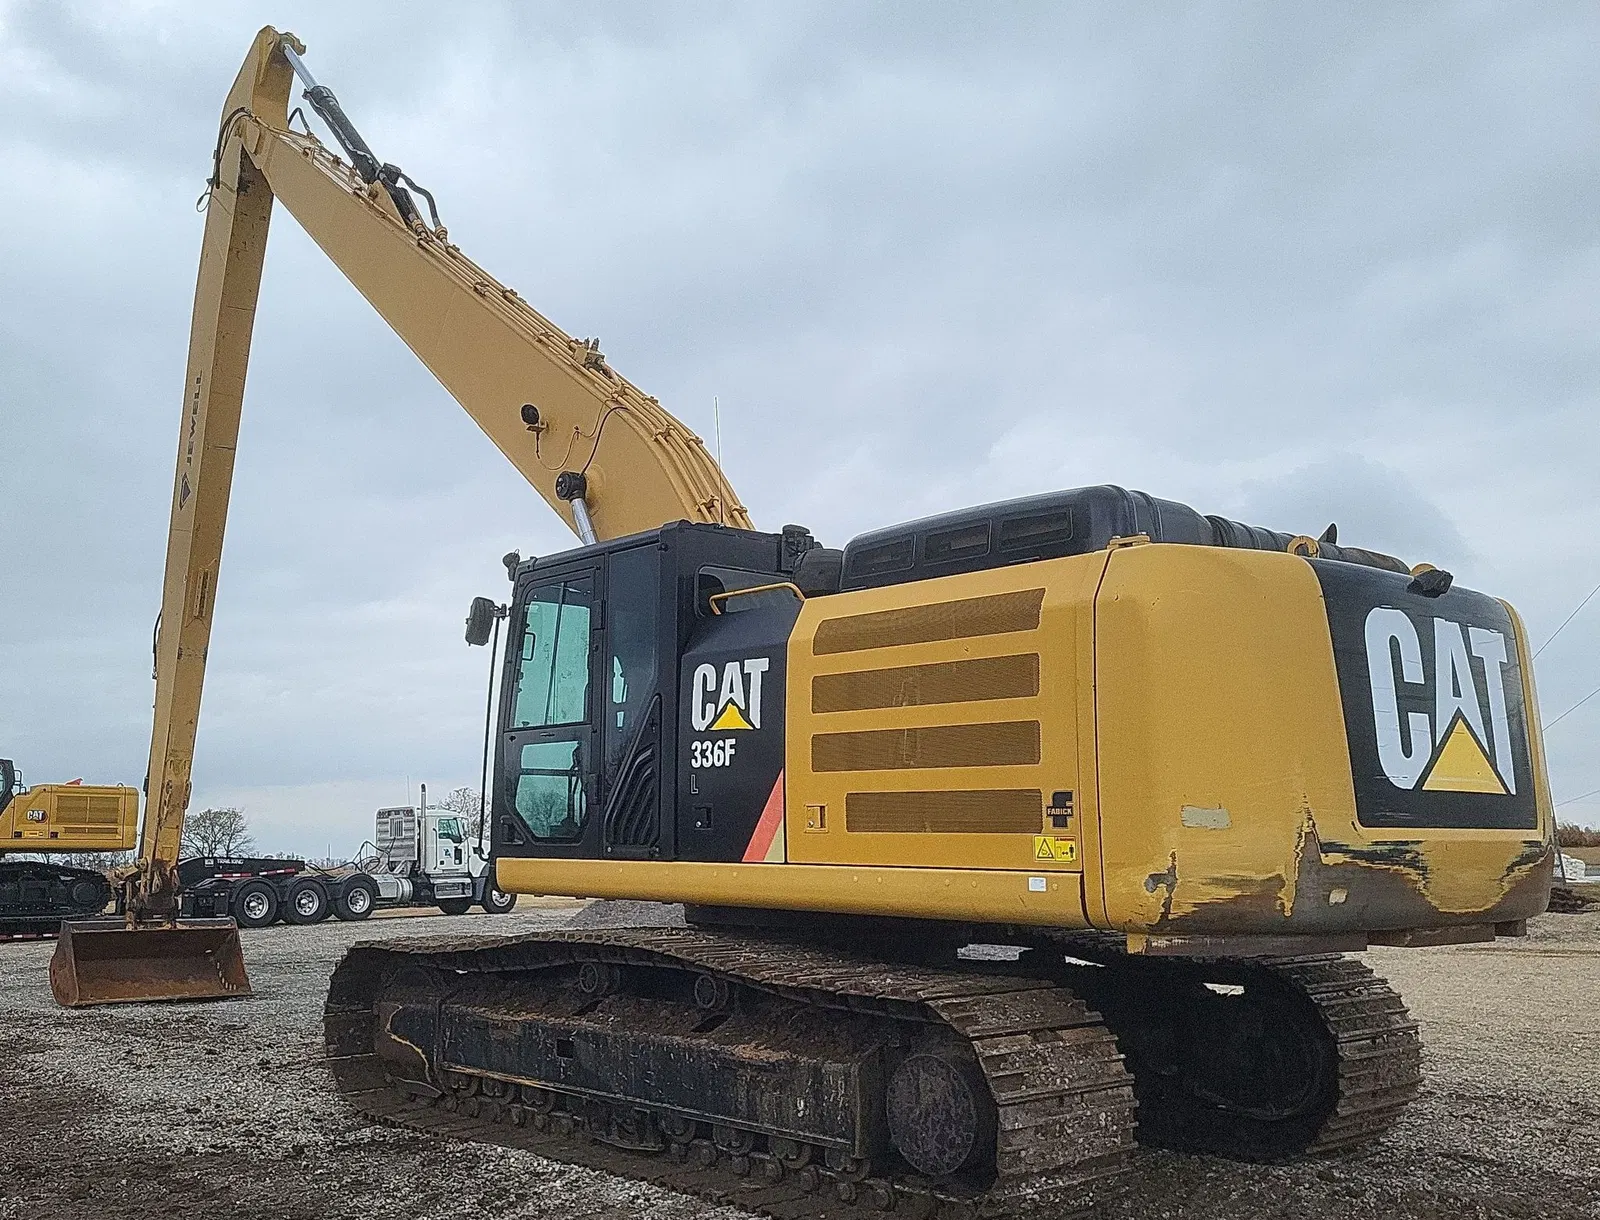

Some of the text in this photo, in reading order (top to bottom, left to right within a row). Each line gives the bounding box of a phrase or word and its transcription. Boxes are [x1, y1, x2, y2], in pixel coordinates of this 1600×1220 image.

[186, 368, 203, 467] JEWELL
[691, 657, 769, 732] CAT
[1364, 606, 1517, 796] CAT
[691, 738, 736, 768] 336F
[690, 774, 699, 794] L
[27, 810, 45, 821] CAT
[1047, 807, 1073, 816] FABICK
